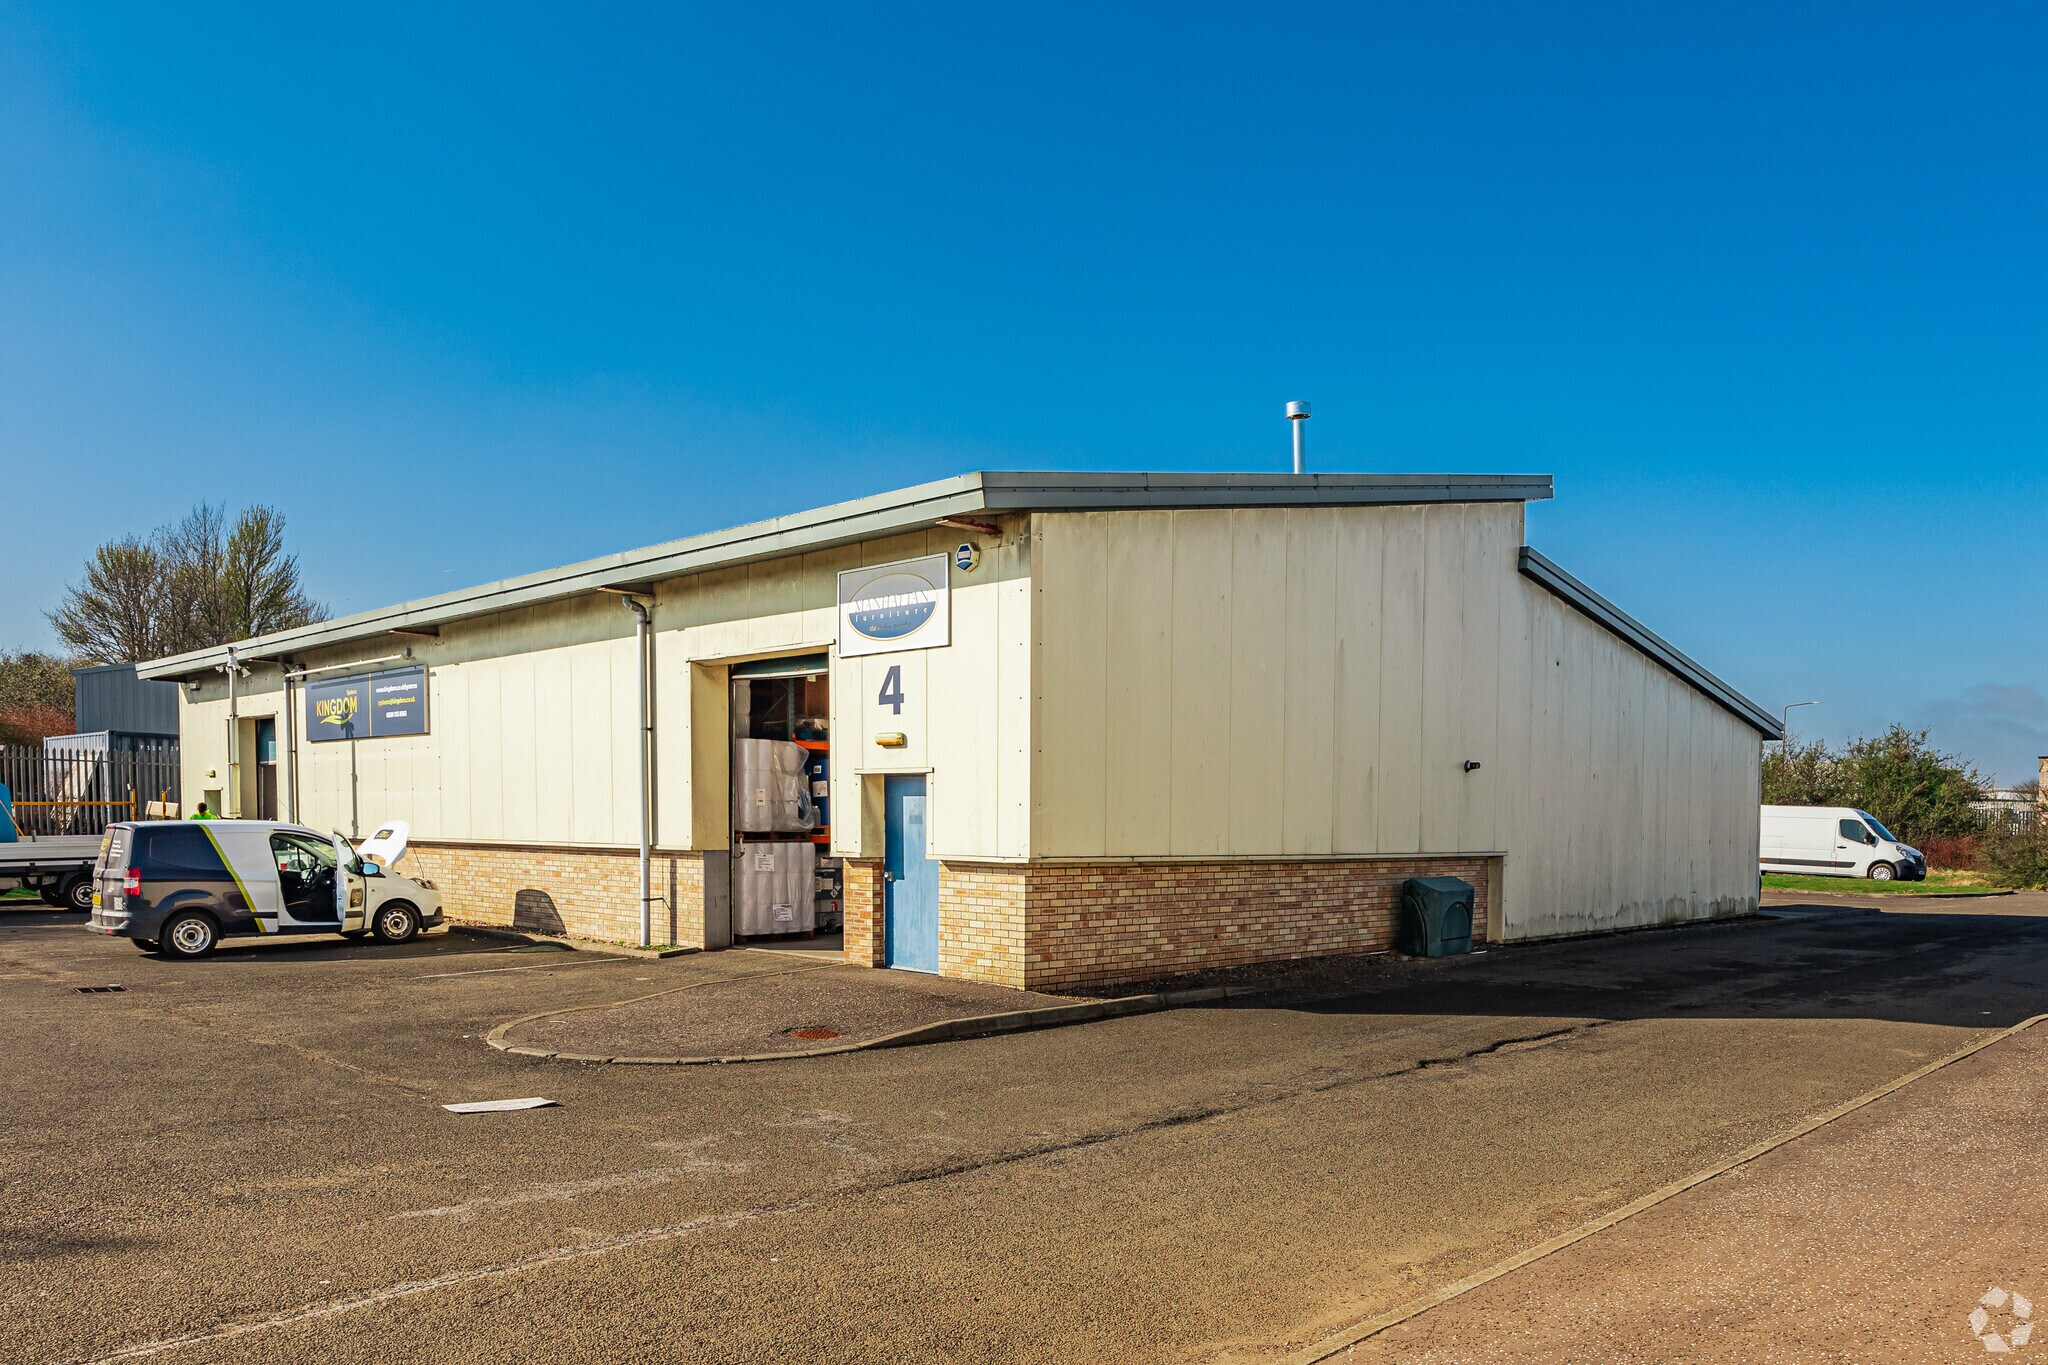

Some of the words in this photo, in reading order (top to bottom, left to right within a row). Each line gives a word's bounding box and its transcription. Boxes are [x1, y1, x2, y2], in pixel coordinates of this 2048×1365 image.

[855, 607, 928, 622] furniture
[879, 665, 904, 714] 4
[316, 696, 358, 717] KINGDOM
